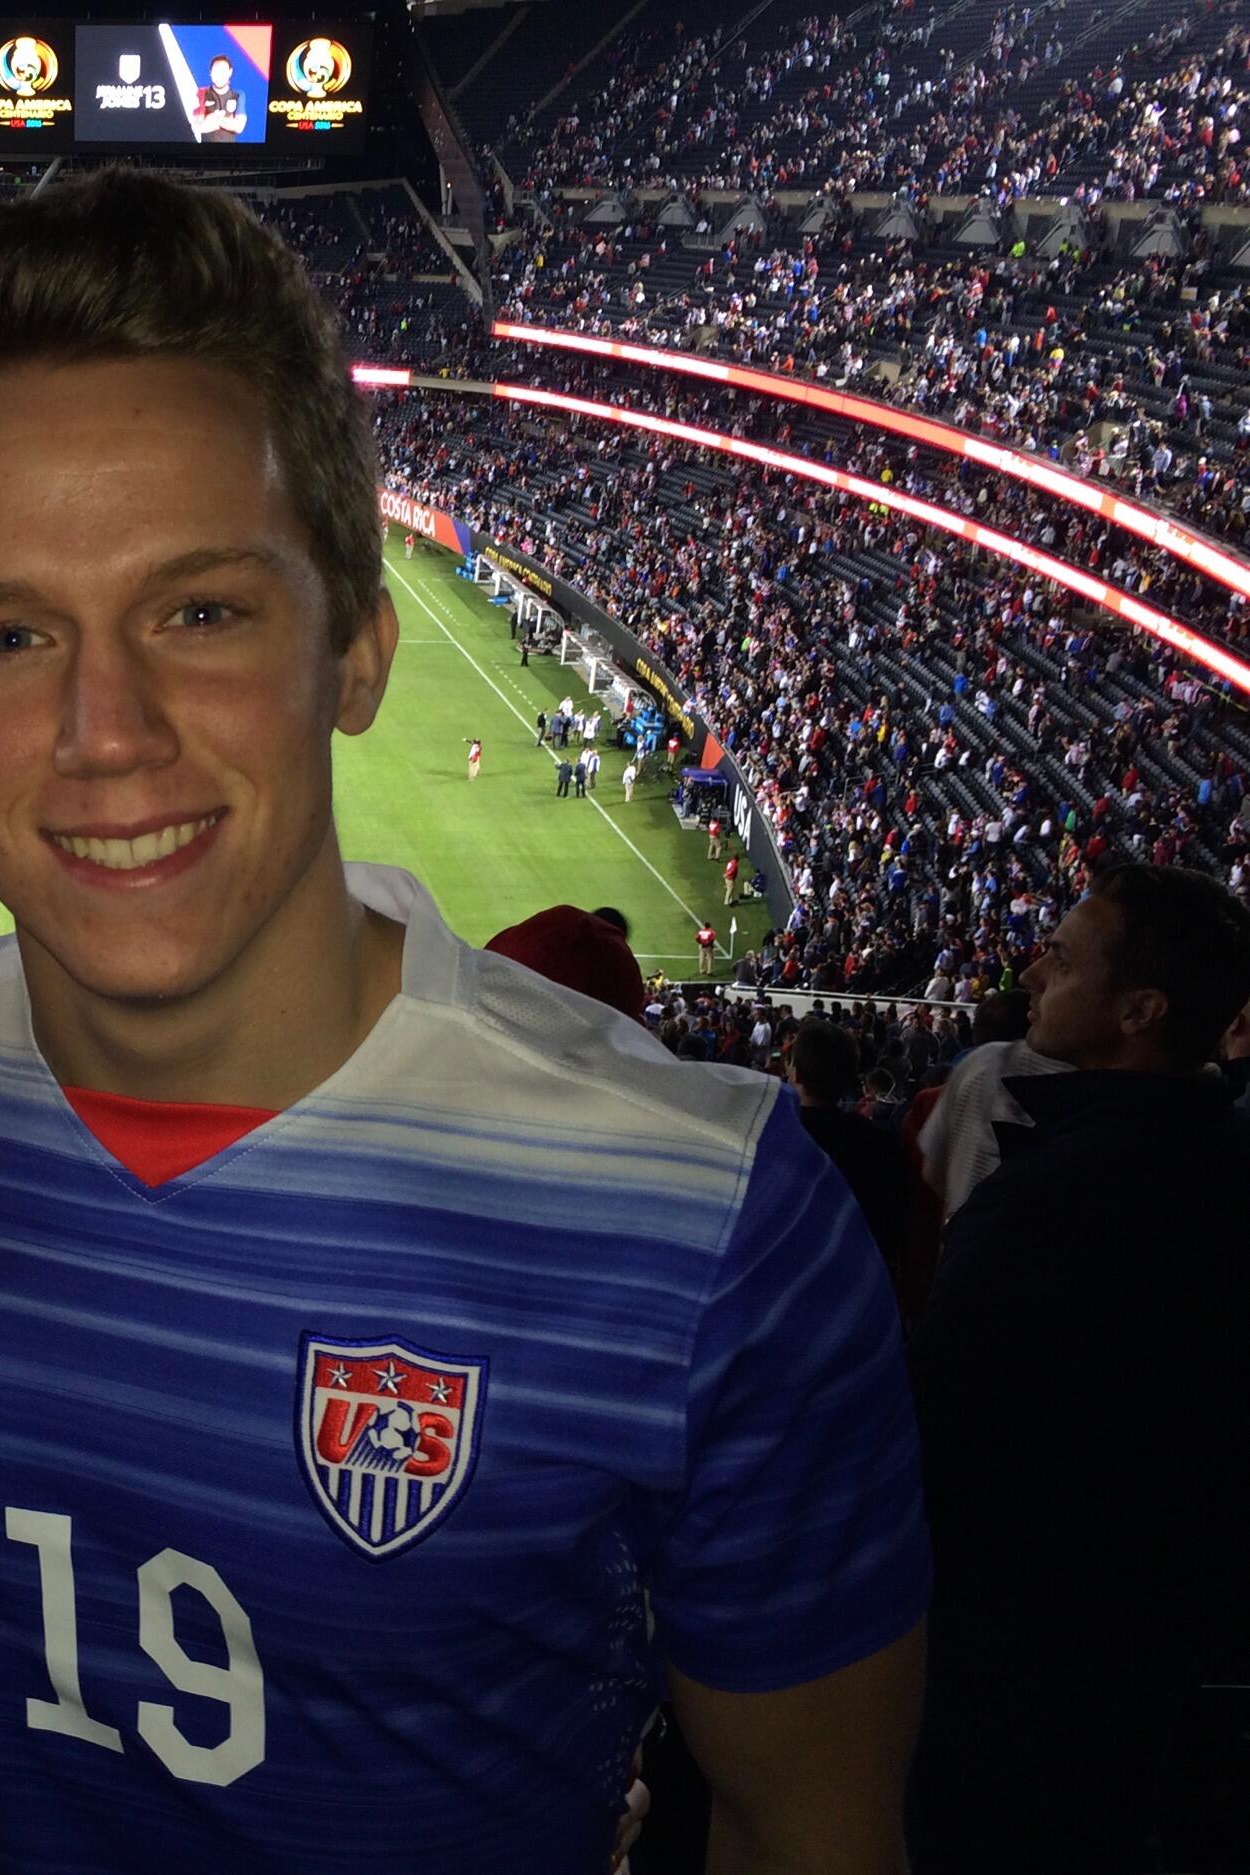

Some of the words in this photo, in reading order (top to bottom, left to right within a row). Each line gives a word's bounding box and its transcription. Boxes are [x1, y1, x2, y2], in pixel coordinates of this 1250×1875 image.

[142, 86, 165, 108] 13
[269, 100, 304, 112] COPA
[380, 492, 412, 528] COSTA
[412, 506, 436, 538] RICA
[733, 783, 752, 851] USA
[316, 1397, 455, 1478] US
[4, 1505, 266, 1787] 19
